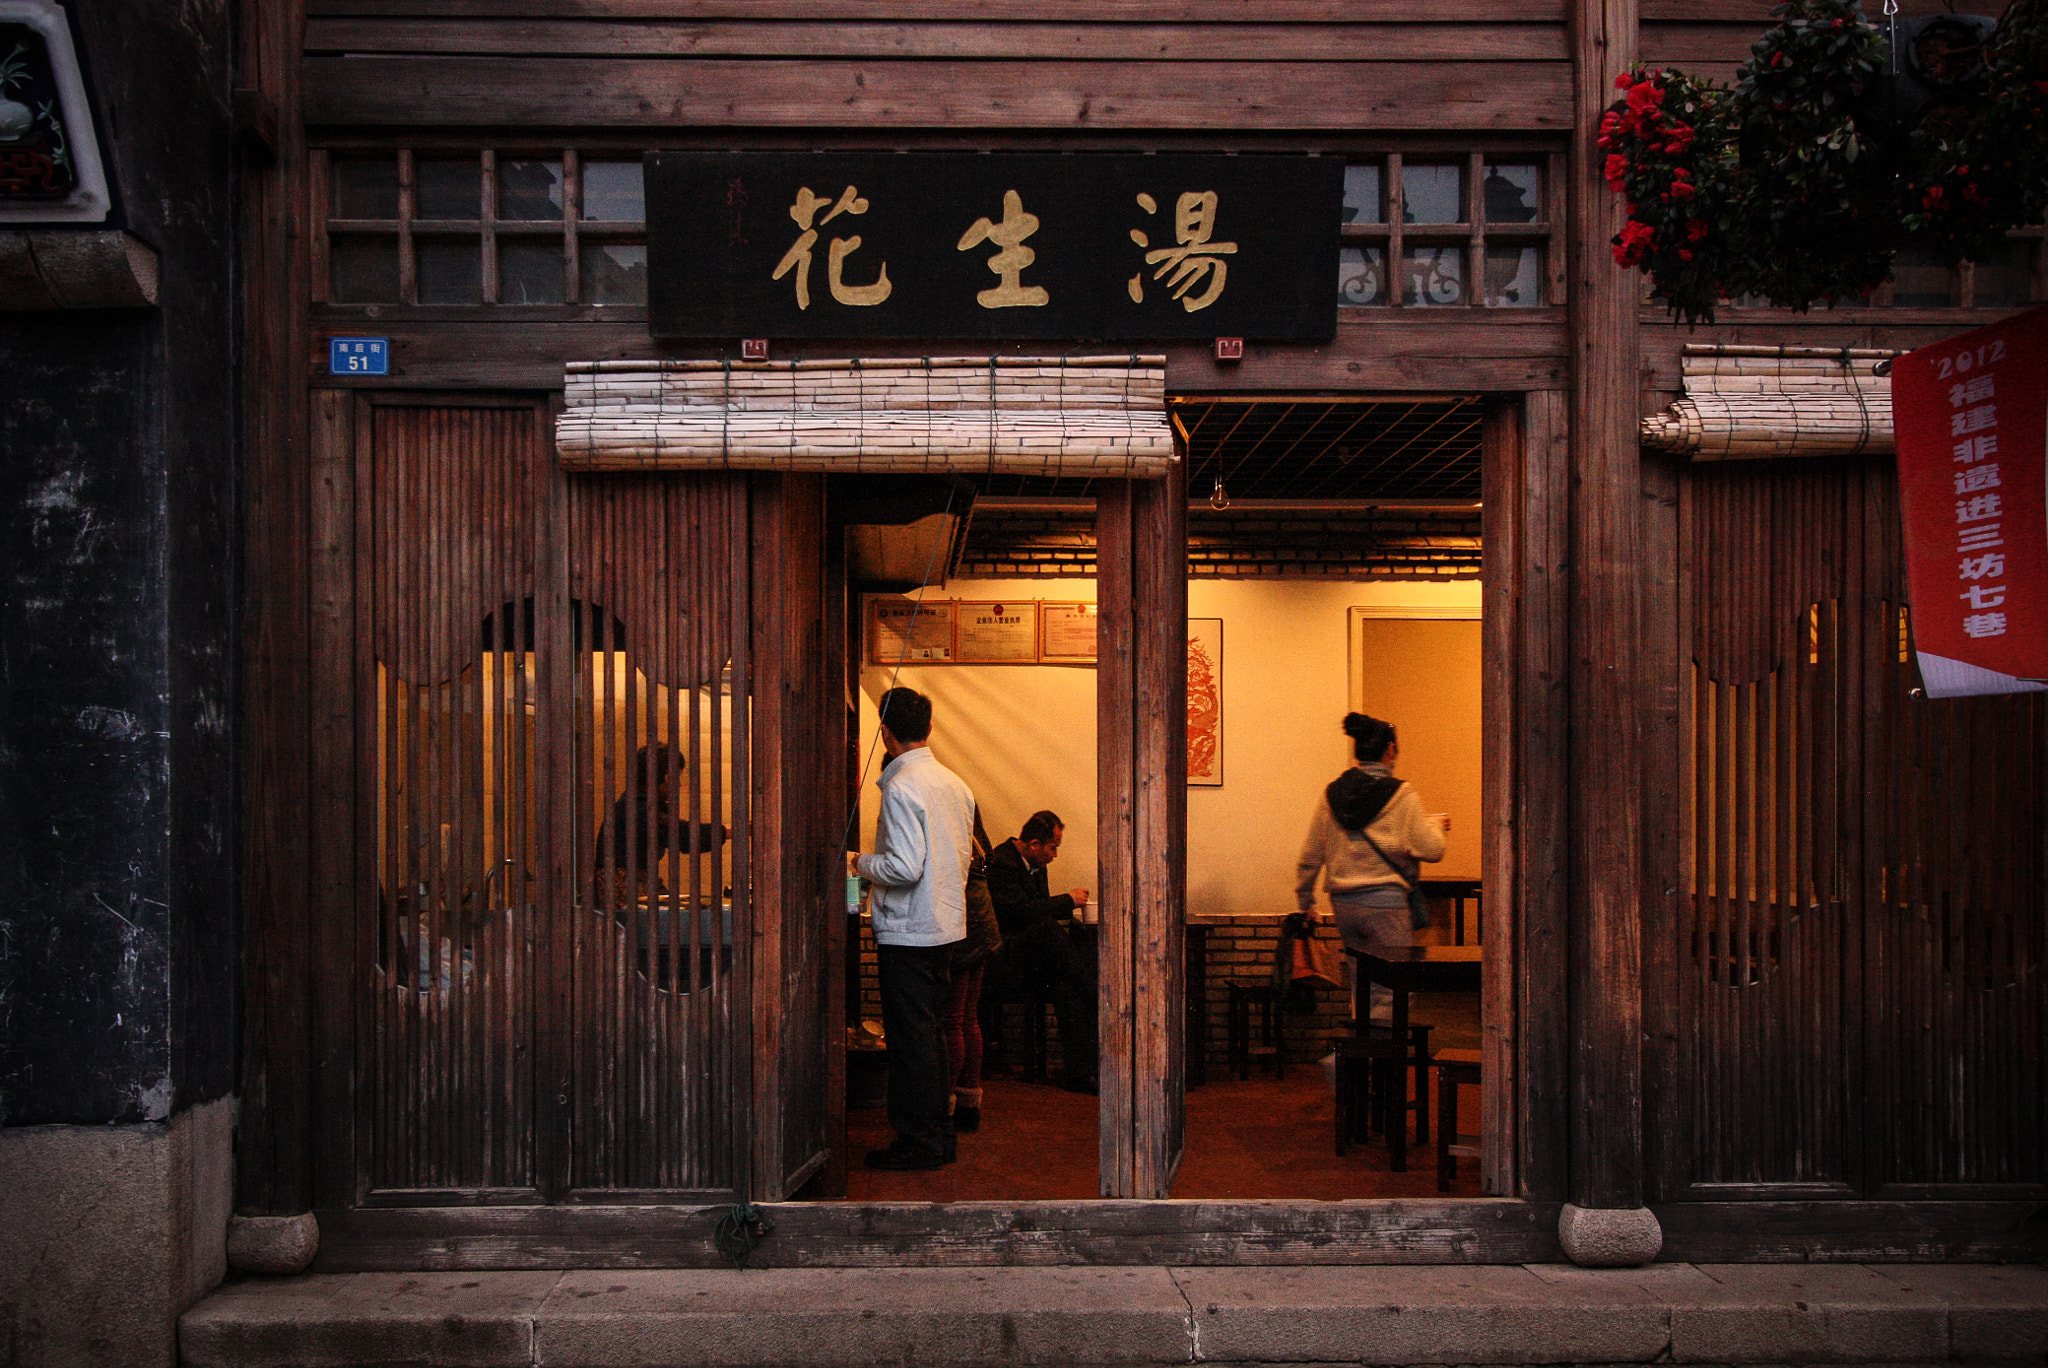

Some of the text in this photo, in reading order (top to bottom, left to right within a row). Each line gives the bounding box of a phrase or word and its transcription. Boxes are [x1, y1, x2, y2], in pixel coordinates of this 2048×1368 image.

[773, 186, 1237, 312] 花生湯
[349, 356, 368, 370] 51
[1949, 373, 2007, 639] 福建非遗进三坊七巷
